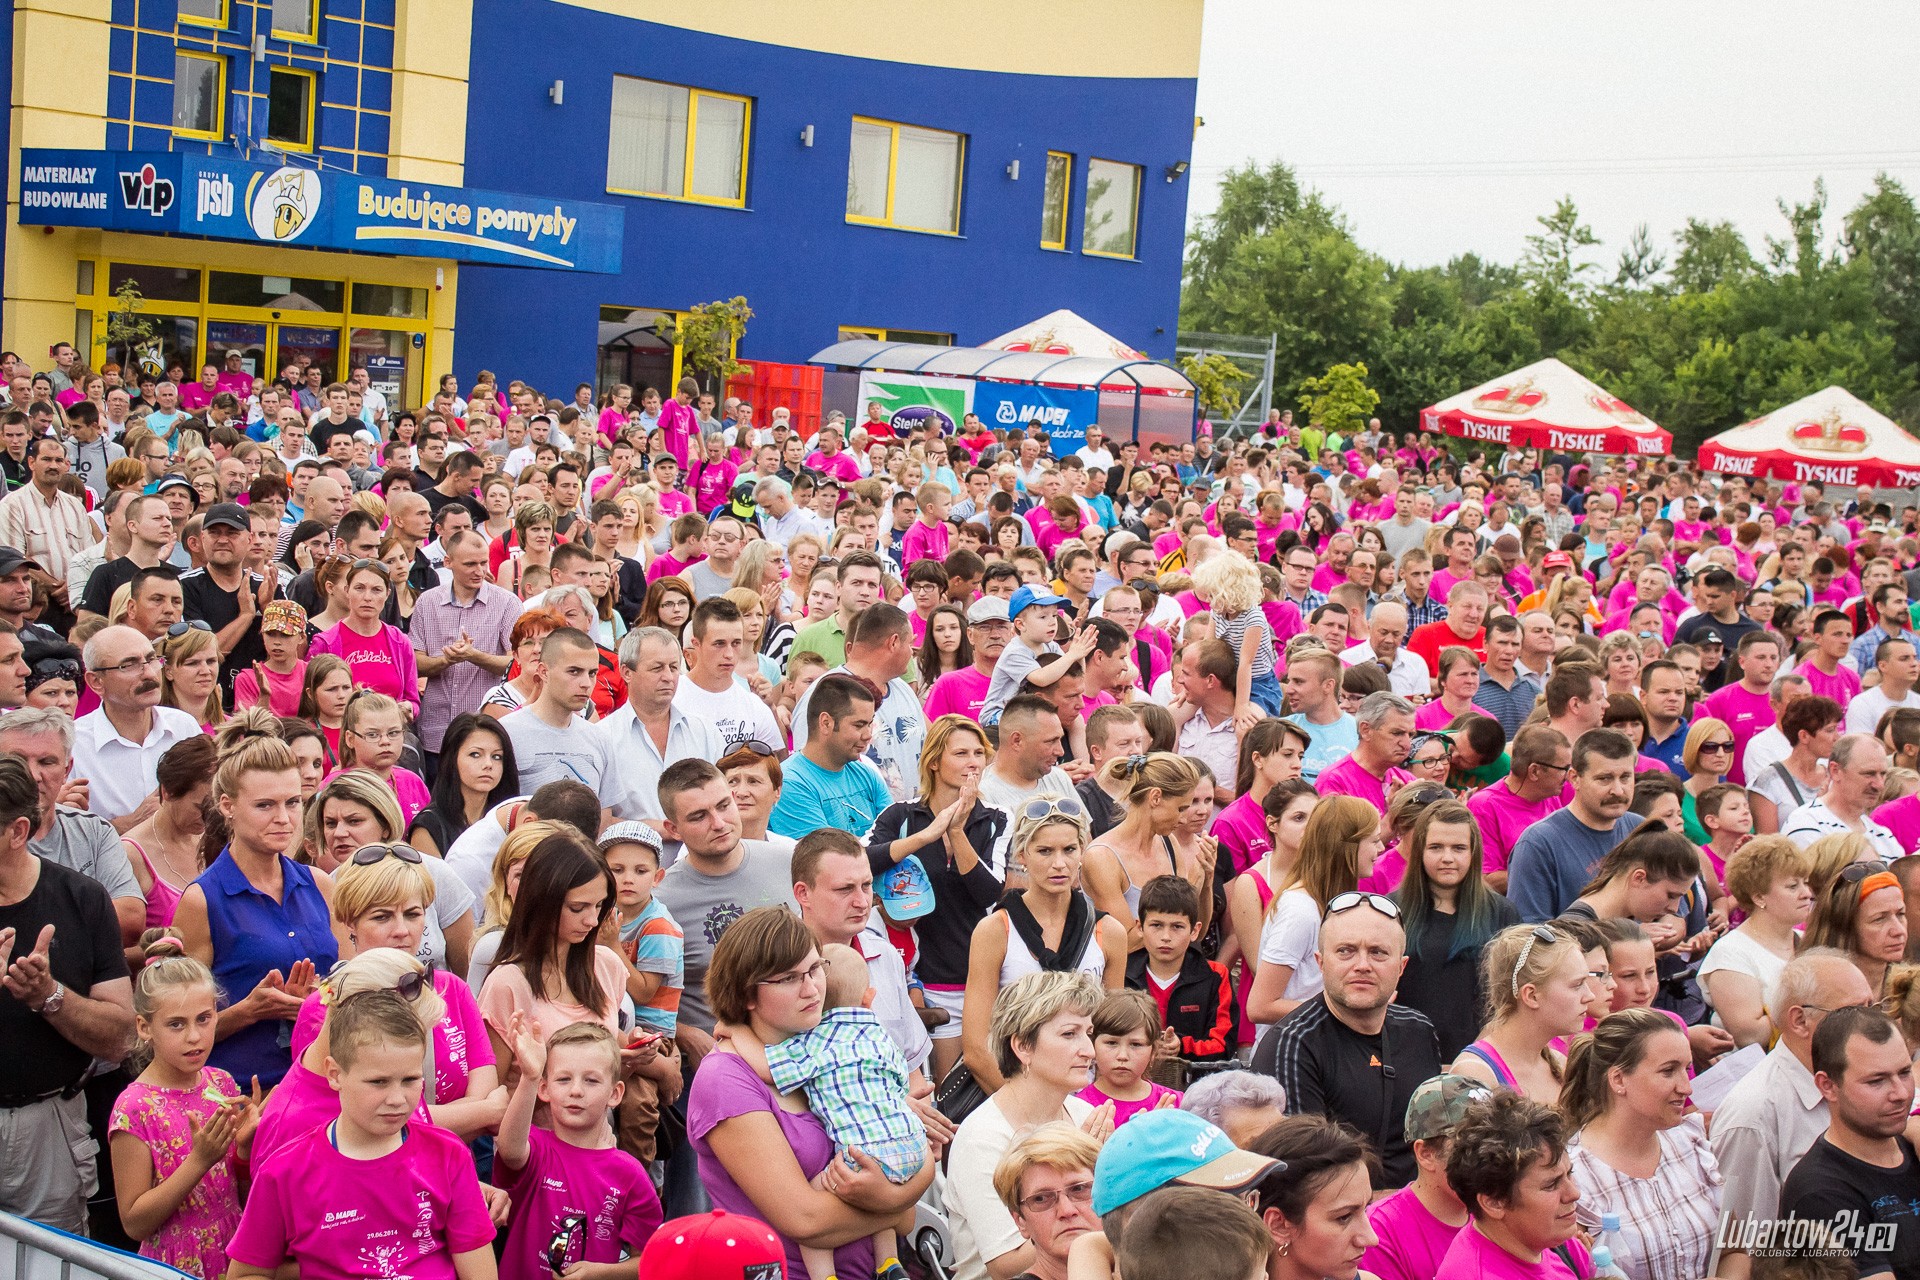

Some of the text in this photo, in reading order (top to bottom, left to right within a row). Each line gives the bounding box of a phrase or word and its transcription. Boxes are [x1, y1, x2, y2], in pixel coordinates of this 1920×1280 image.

[24, 166, 97, 184] MATERIAŁY
[23, 190, 108, 210] BUDOWLANE
[196, 173, 234, 222] psb
[358, 184, 577, 245] Budujące pomysły
[1018, 404, 1070, 426] MAPEI
[1460, 418, 1512, 444] TYSKIE
[1548, 429, 1607, 452] TYSKIE
[1634, 435, 1665, 454] TYSKIE
[1712, 451, 1758, 475] TYSKIE
[1793, 461, 1859, 486] TYSKIE
[335, 1209, 358, 1220] MAPEI
[366, 1229, 399, 1240] 29.06.2014
